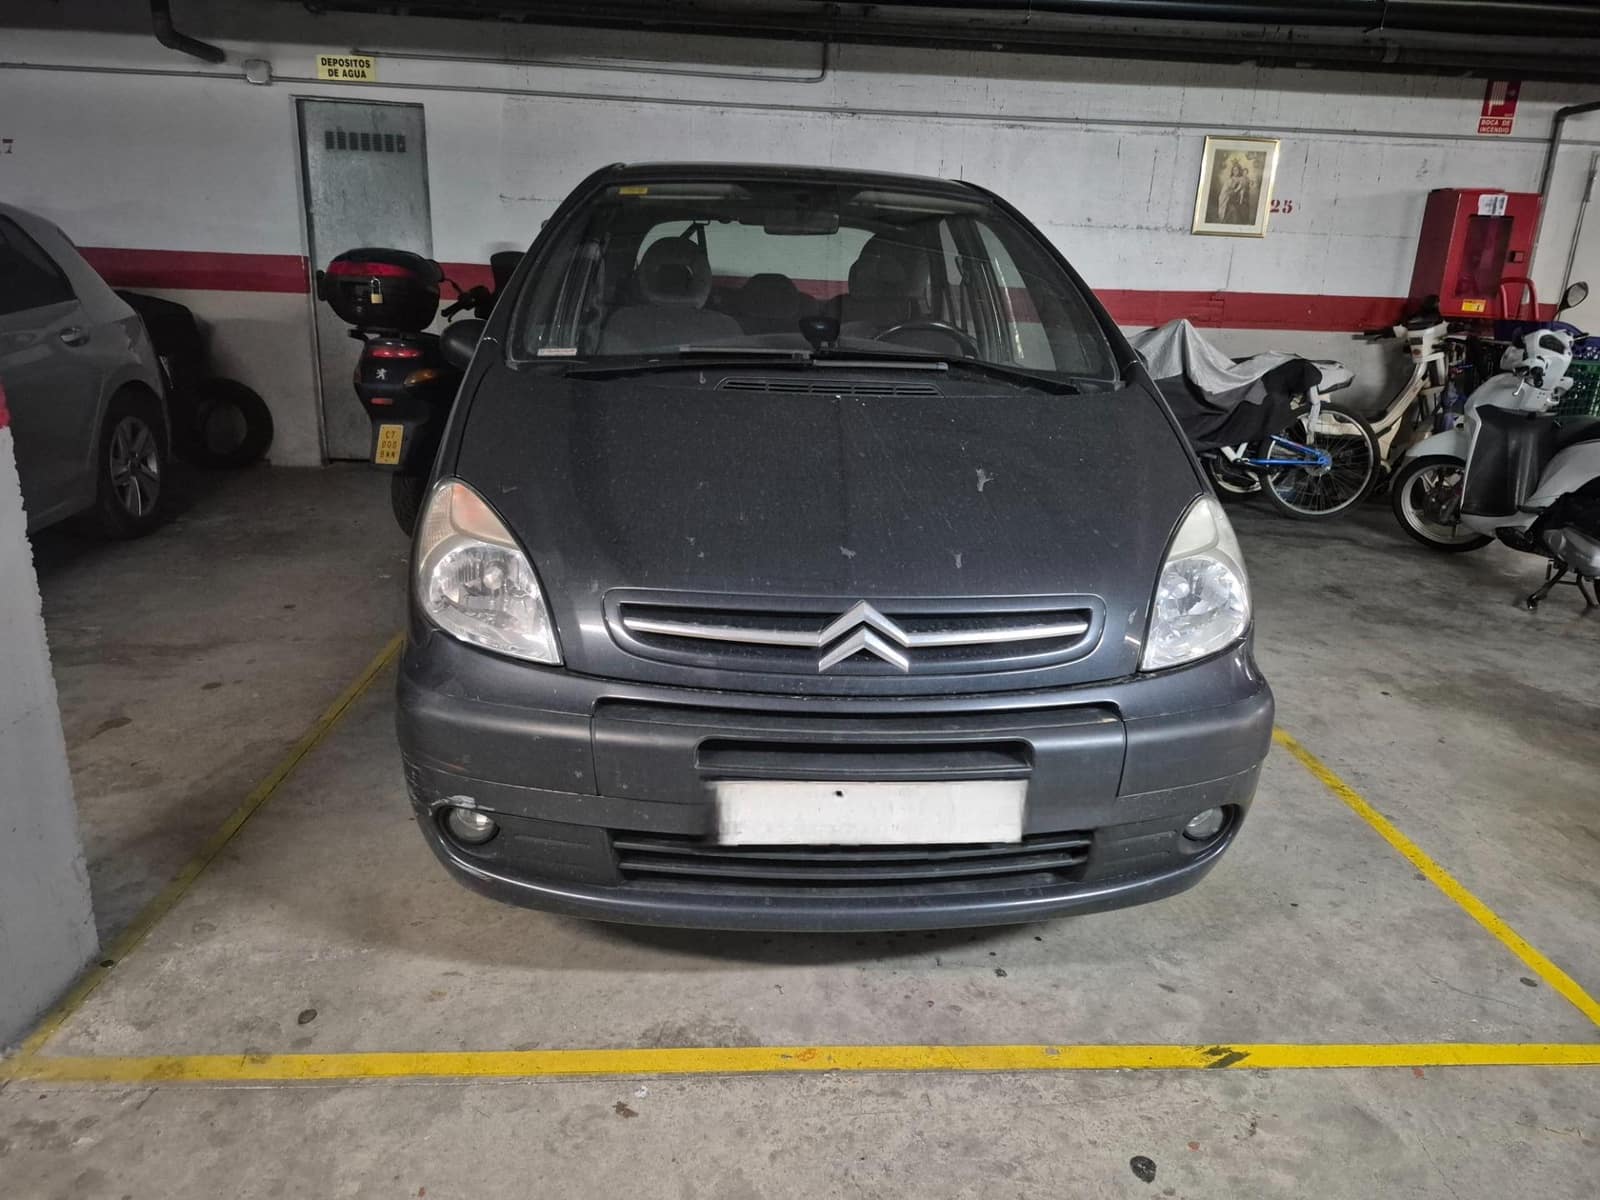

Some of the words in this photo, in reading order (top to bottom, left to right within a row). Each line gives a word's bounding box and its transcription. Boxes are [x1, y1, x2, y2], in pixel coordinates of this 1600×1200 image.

[320, 57, 371, 69] DEPOSITOS
[327, 68, 340, 78] DE
[342, 69, 367, 79] AGUA
[1269, 199, 1293, 214] 25
